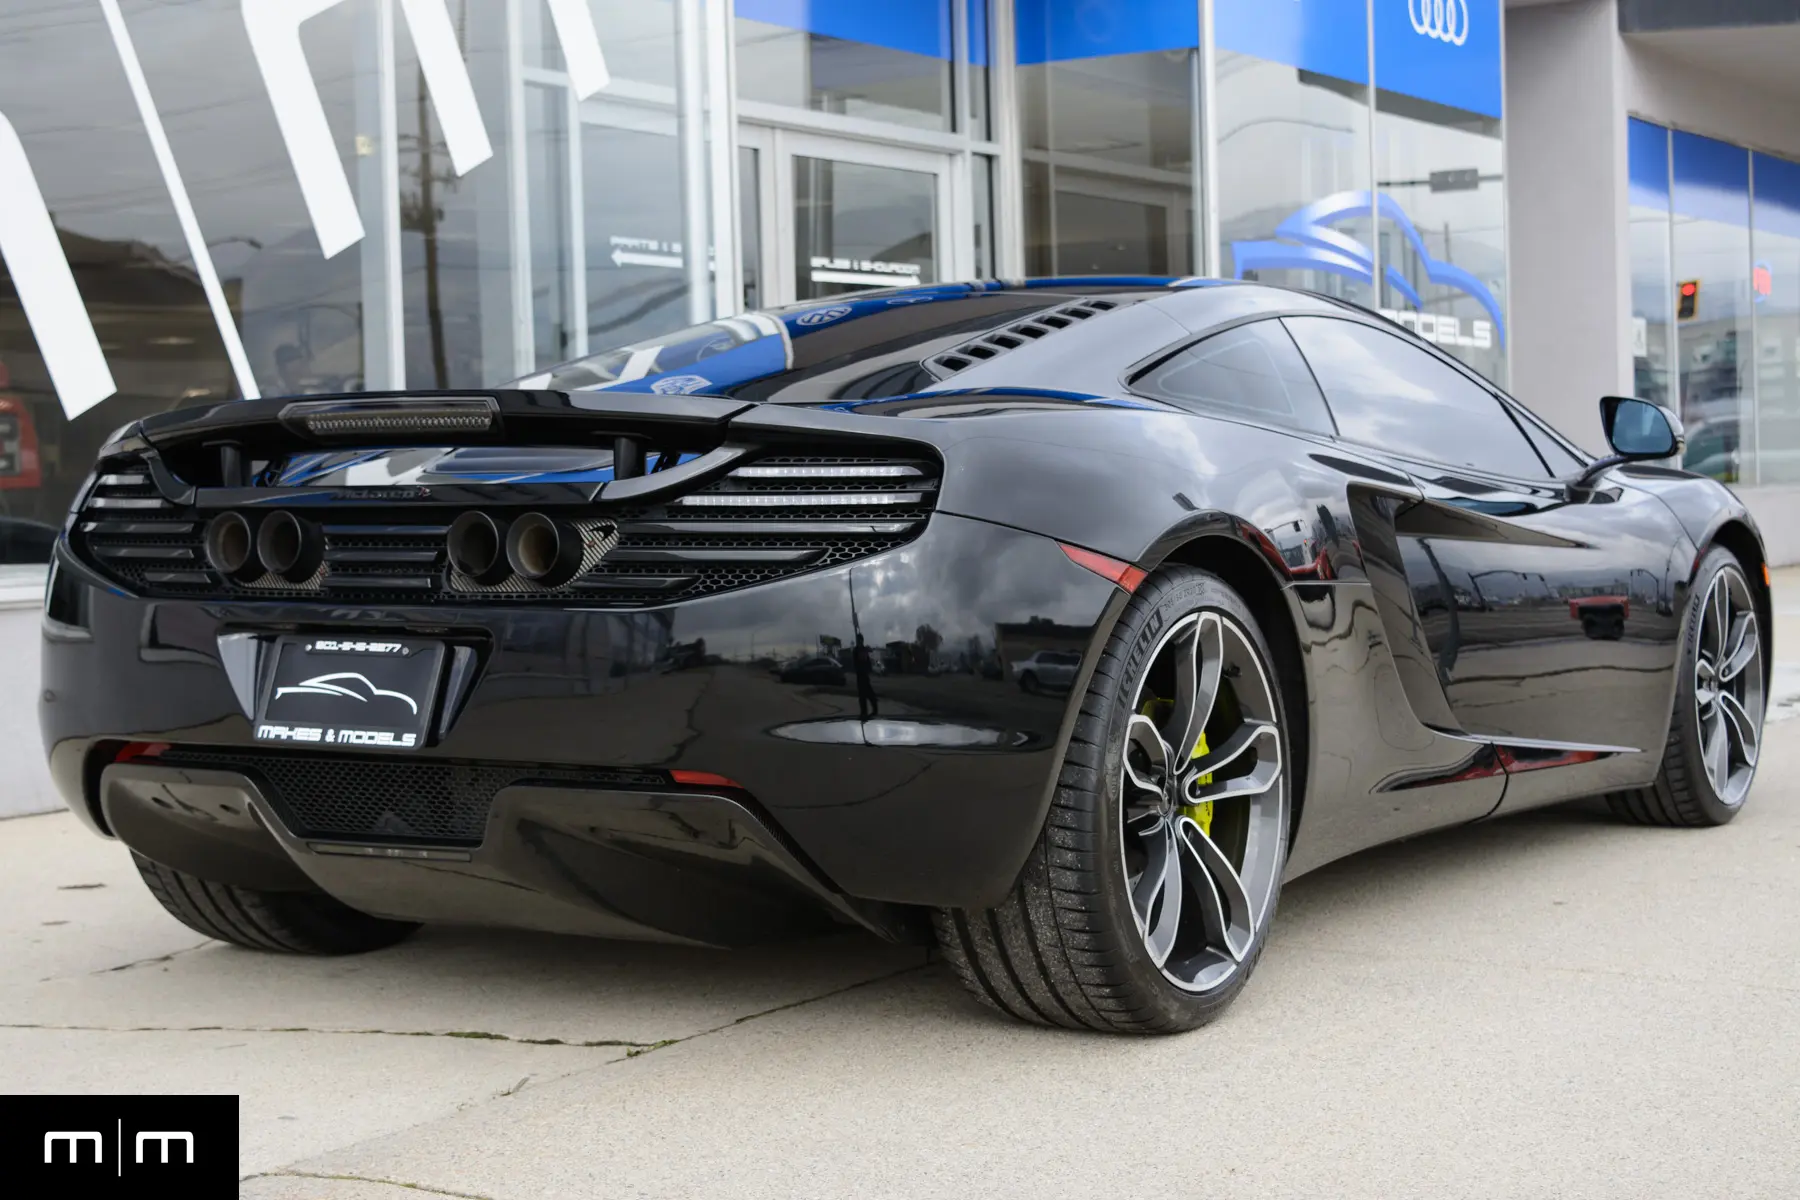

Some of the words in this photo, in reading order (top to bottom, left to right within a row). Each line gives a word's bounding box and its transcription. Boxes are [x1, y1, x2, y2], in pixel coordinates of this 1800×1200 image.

[257, 724, 323, 742] MAKES
[324, 728, 336, 743] &
[337, 729, 417, 747] MODELS
